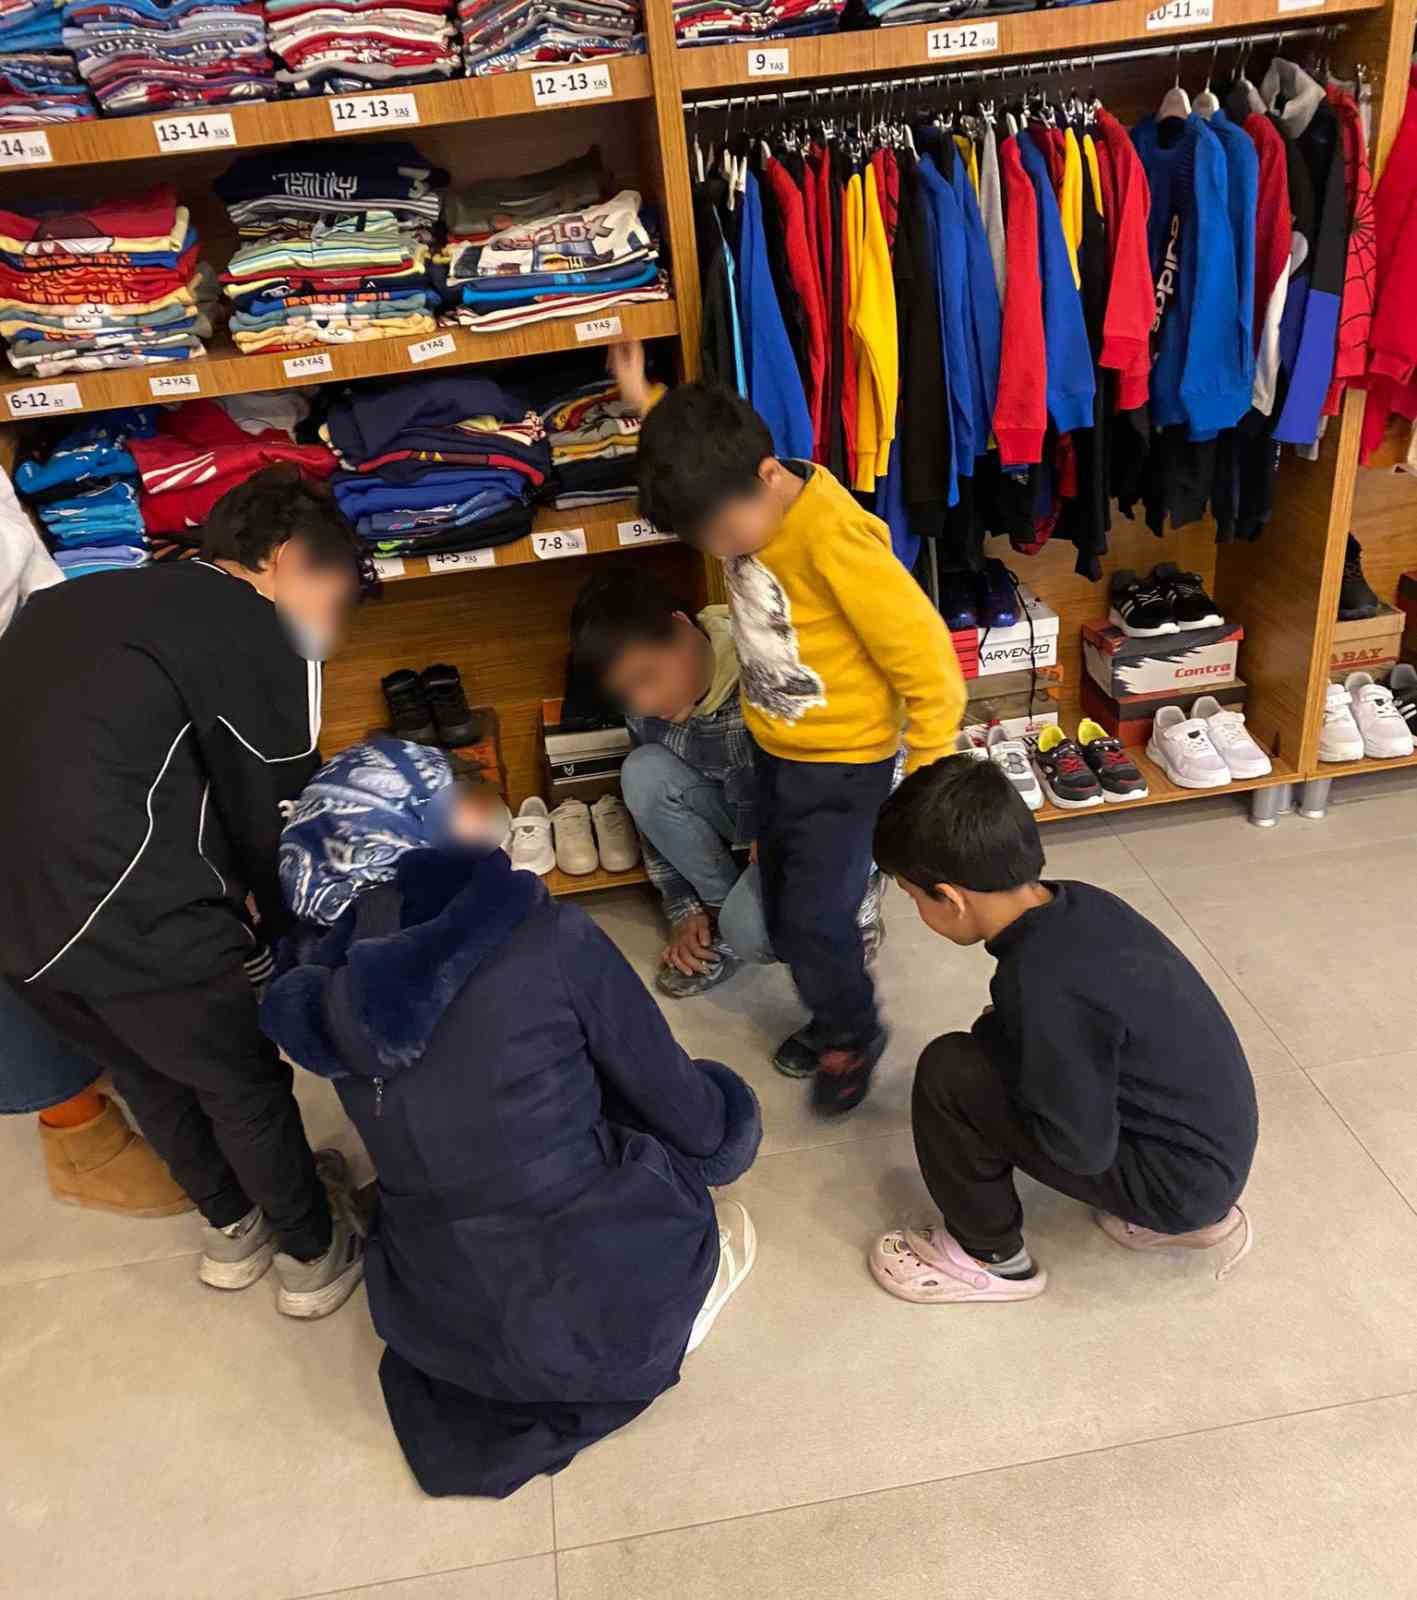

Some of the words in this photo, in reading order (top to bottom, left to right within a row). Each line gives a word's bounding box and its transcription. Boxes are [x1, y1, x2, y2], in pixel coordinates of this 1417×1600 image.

[932, 31, 978, 50] 11-12
[756, 53, 766, 71] 9
[535, 77, 557, 96] 12
[335, 102, 355, 120] 12
[158, 121, 209, 142] 13-14
[0, 138, 25, 156] 14
[10, 392, 49, 409] 6-12
[632, 523, 657, 537] 9-1
[538, 536, 563, 551] 7-8
[983, 643, 1050, 662] ARVENZO
[1174, 663, 1231, 678] Contra
